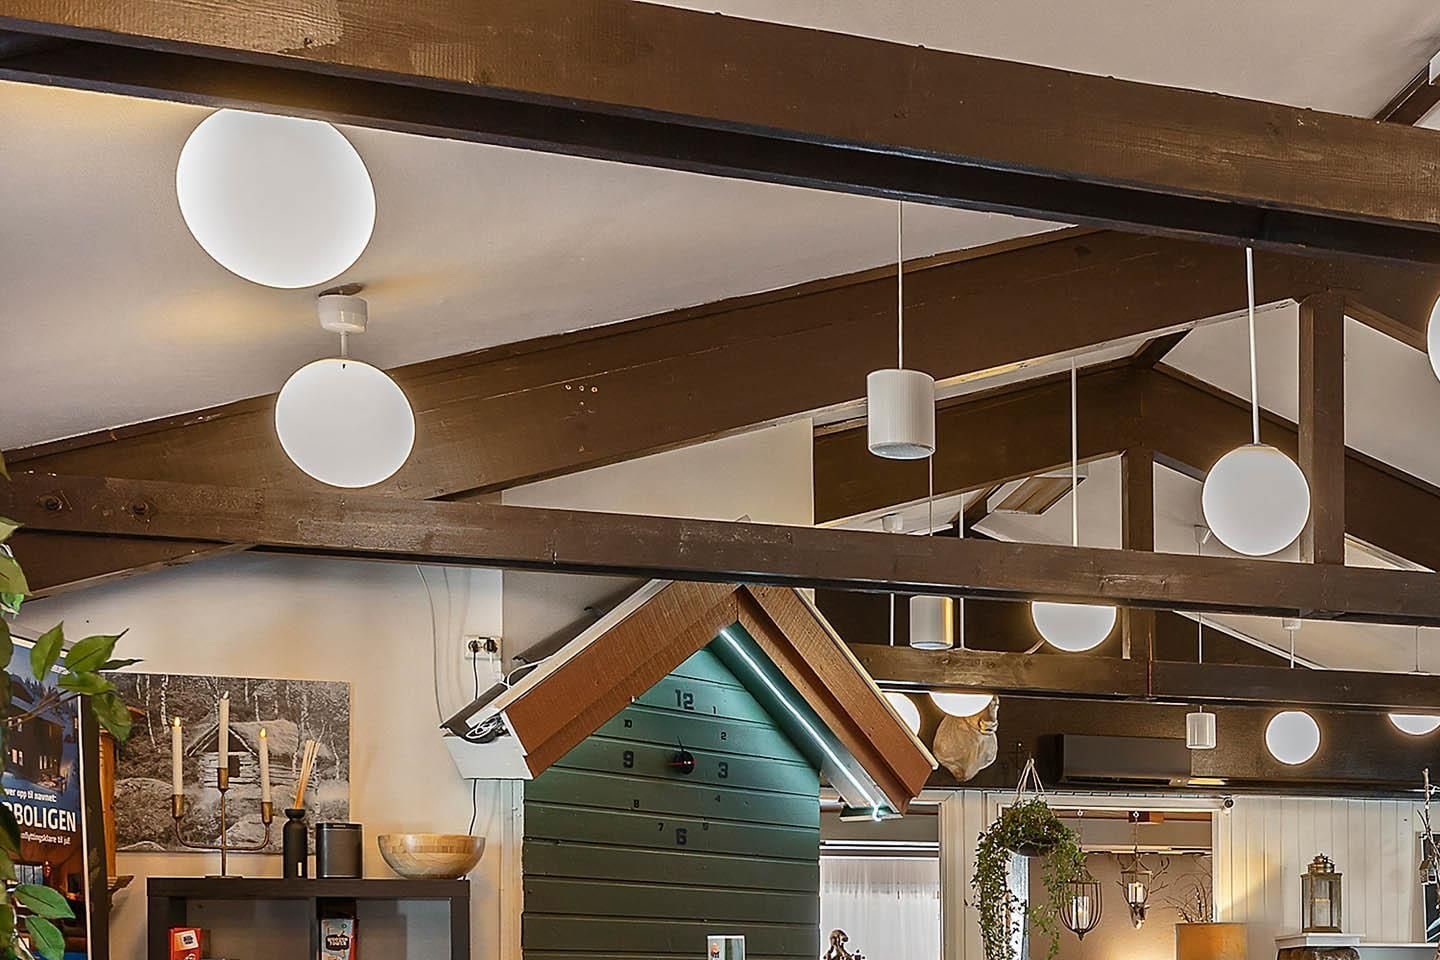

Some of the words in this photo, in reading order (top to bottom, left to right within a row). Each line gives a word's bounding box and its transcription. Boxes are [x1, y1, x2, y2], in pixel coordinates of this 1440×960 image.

[675, 689, 695, 710] 12
[624, 719, 633, 729] 10
[720, 731, 727, 741] 2
[623, 750, 634, 769] 9
[718, 761, 729, 779] 3
[4, 788, 17, 797] ver
[17, 790, 27, 800] opp
[714, 795, 721, 803] 4
[633, 799, 640, 809] 8
[2, 801, 77, 833] BOLIGEN
[657, 822, 664, 832] 7
[676, 828, 688, 846] 6
